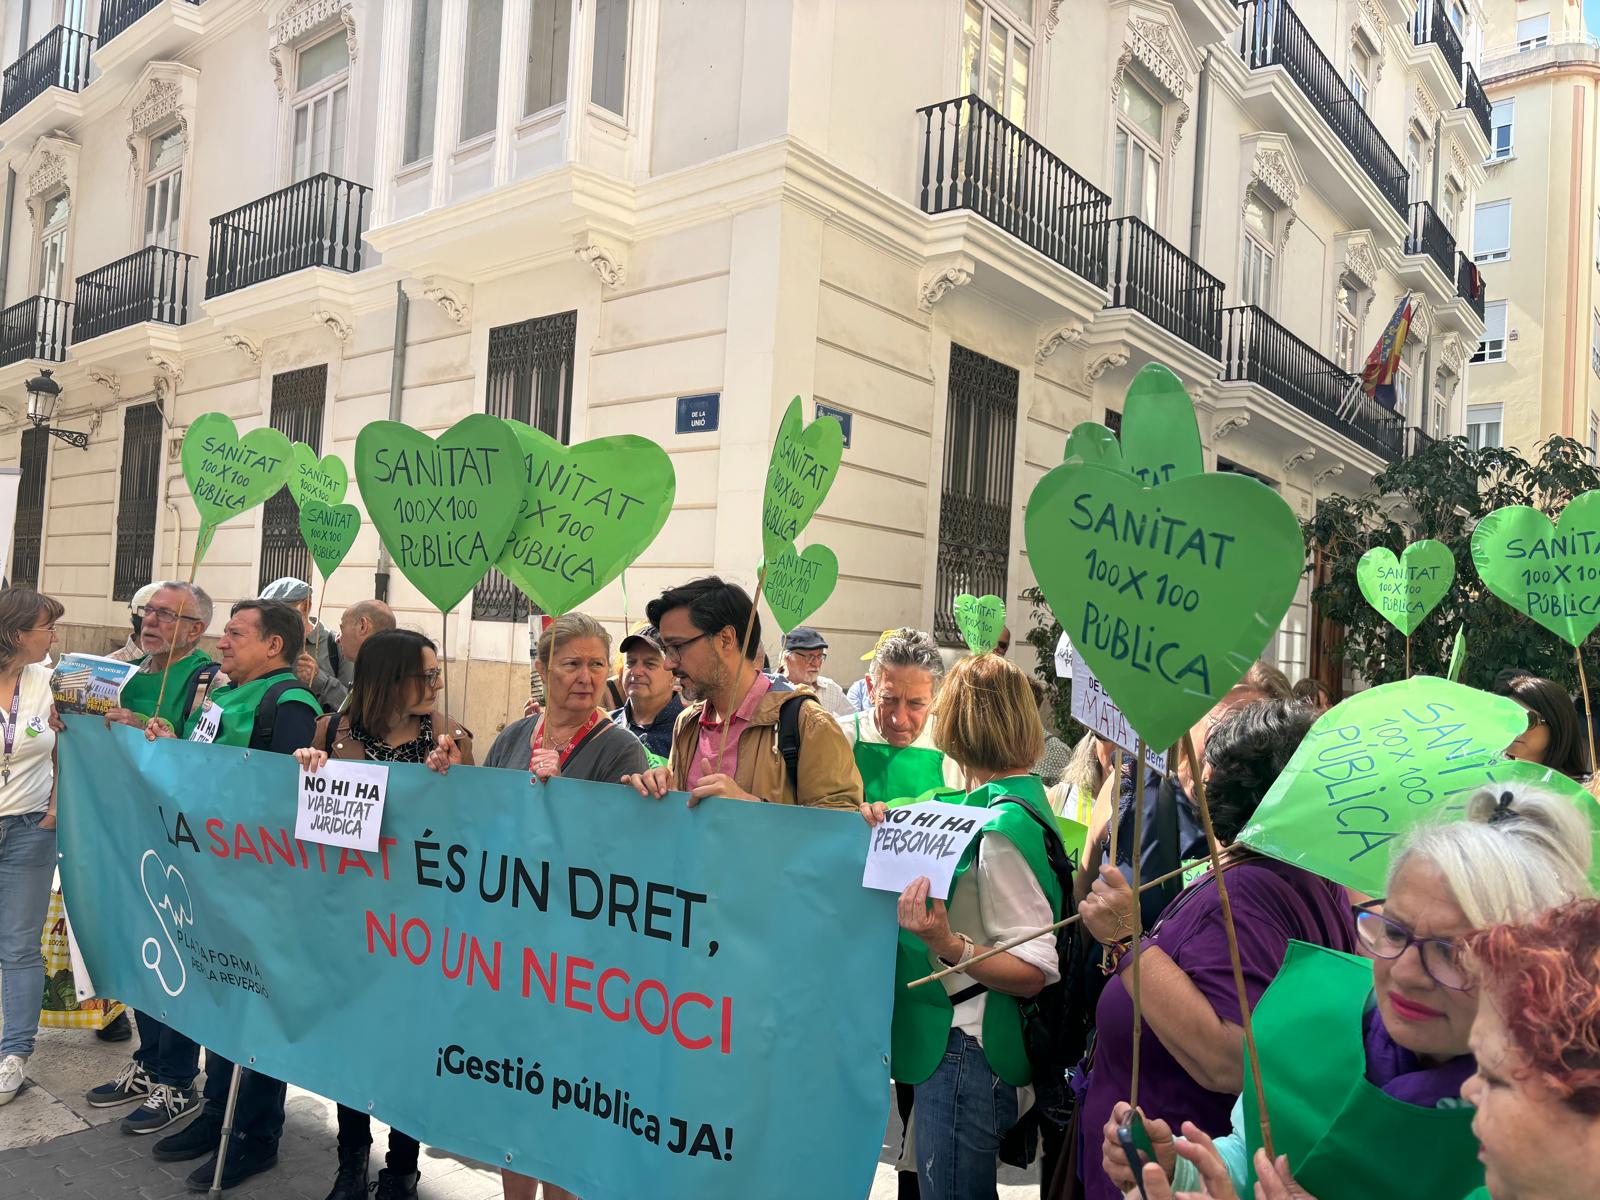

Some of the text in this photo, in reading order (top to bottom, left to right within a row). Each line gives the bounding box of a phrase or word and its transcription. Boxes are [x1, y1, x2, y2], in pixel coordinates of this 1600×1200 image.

[522, 452, 645, 521] ANiTAT
[393, 496, 477, 523] 100X100
[1522, 564, 1600, 586] 100X10
[1089, 676, 1099, 692] DE
[304, 775, 380, 801] NO HI HA
[307, 794, 374, 821] VIABILITAT
[911, 812, 943, 828] HI
[939, 817, 977, 834] HA
[873, 826, 957, 860] PERSONAL
[158, 805, 201, 853] LA
[414, 828, 468, 893] ÉS
[479, 850, 550, 913] UN
[567, 866, 720, 958] DRET,
[365, 910, 733, 1054] NO UN NEGOCI
[435, 1044, 734, 1162] ¡Gestió pública JA!
